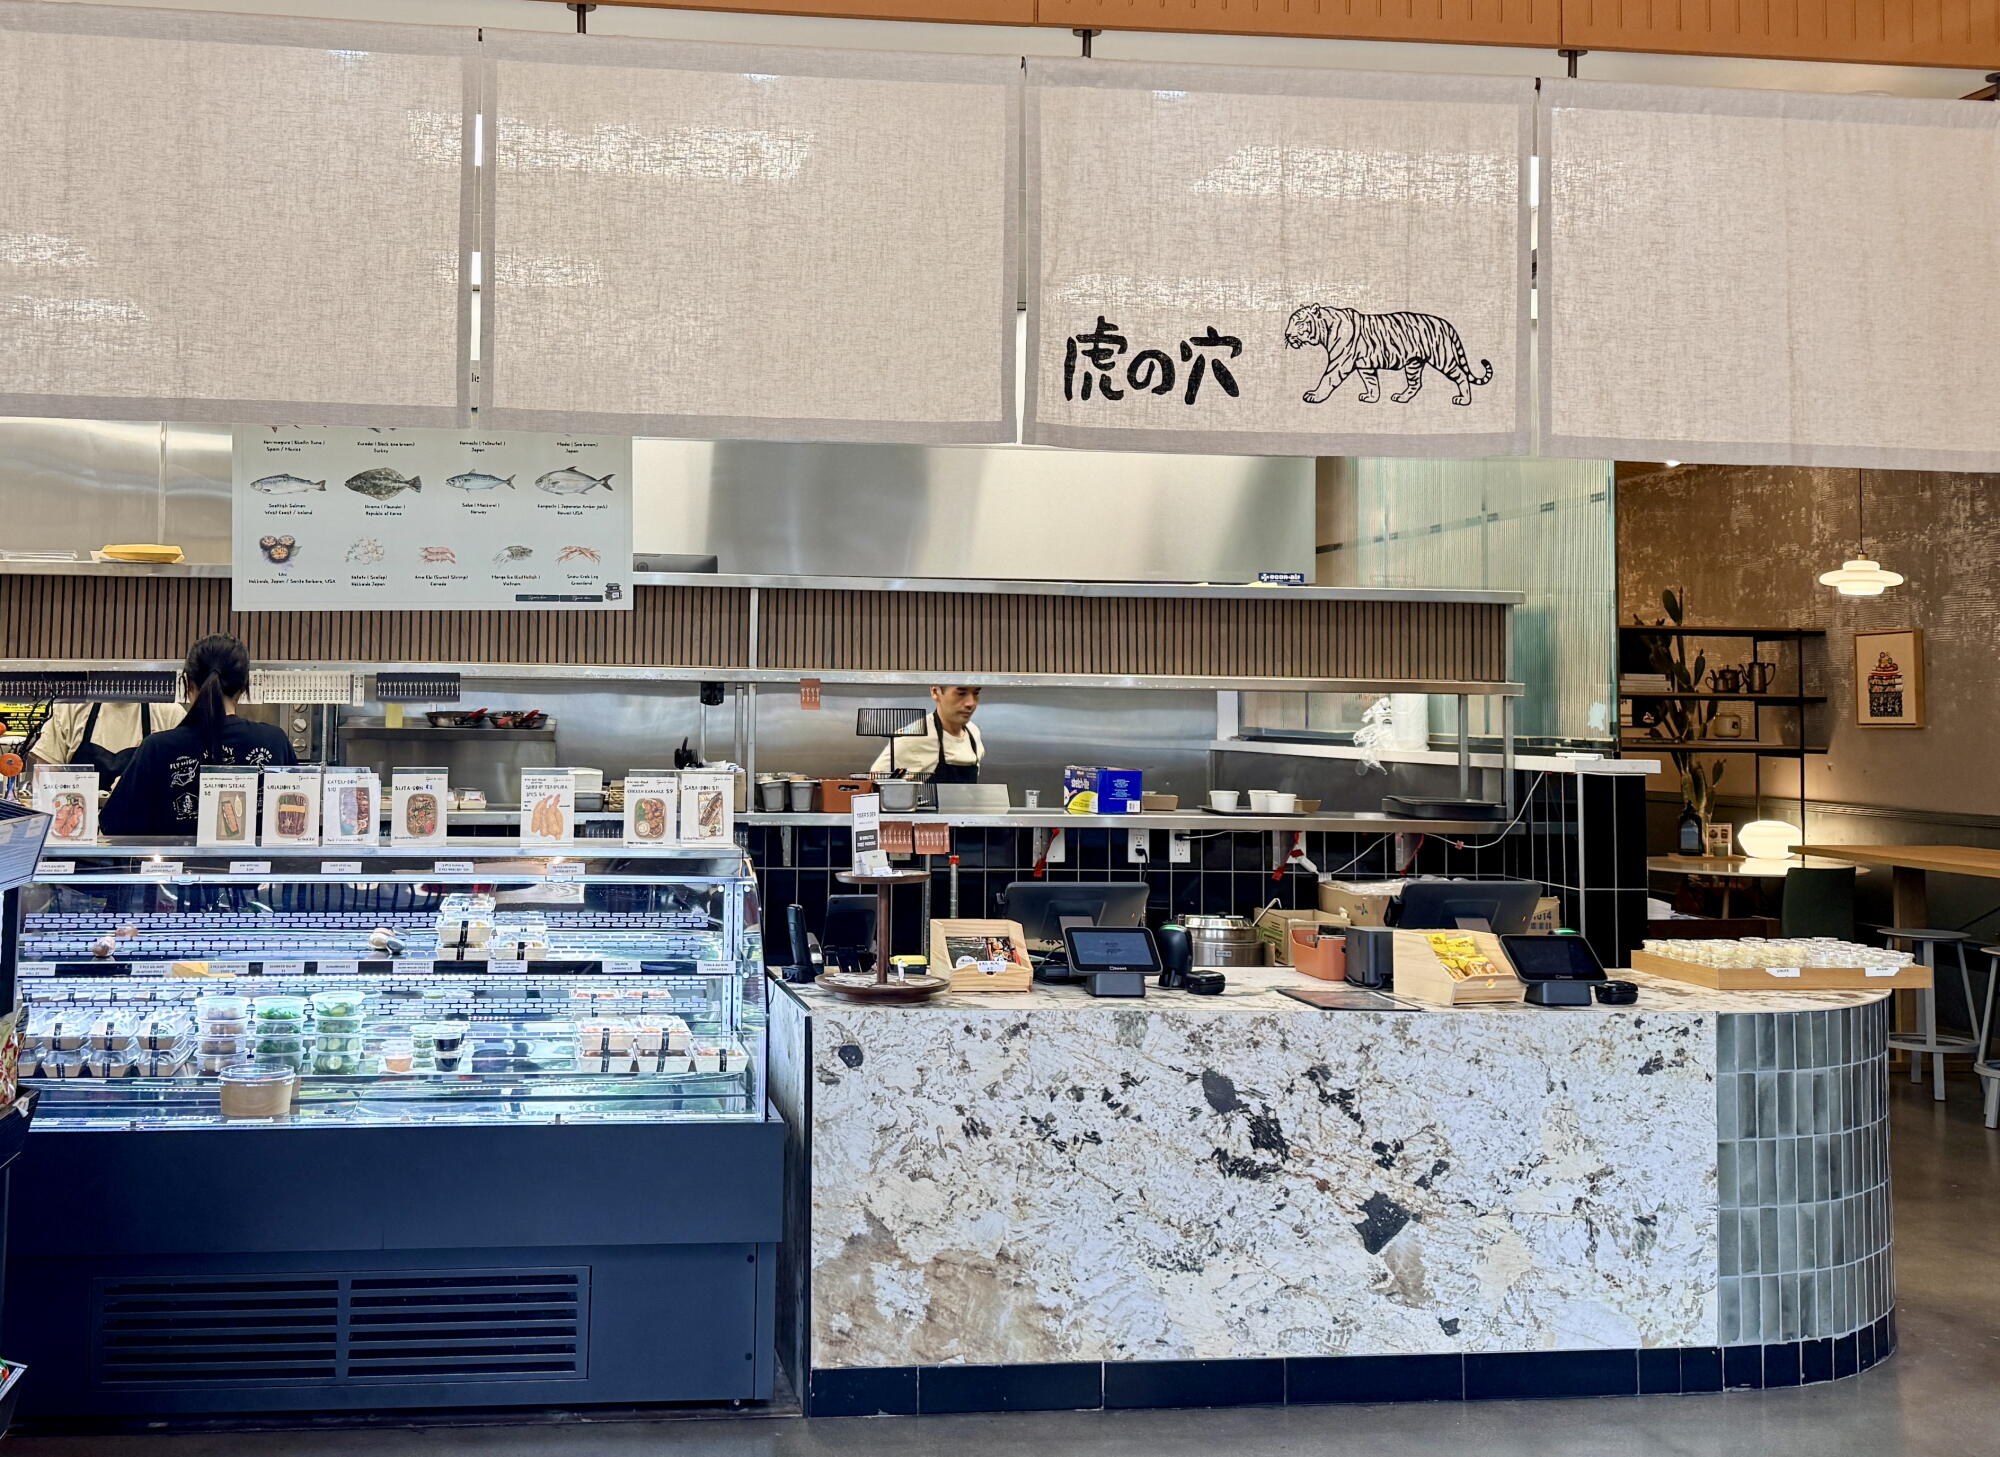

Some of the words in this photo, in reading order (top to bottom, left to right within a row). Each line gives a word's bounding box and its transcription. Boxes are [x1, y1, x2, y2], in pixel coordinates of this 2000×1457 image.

[1064, 315, 1242, 405] 虎の穴
[169, 762, 180, 770] FLY
